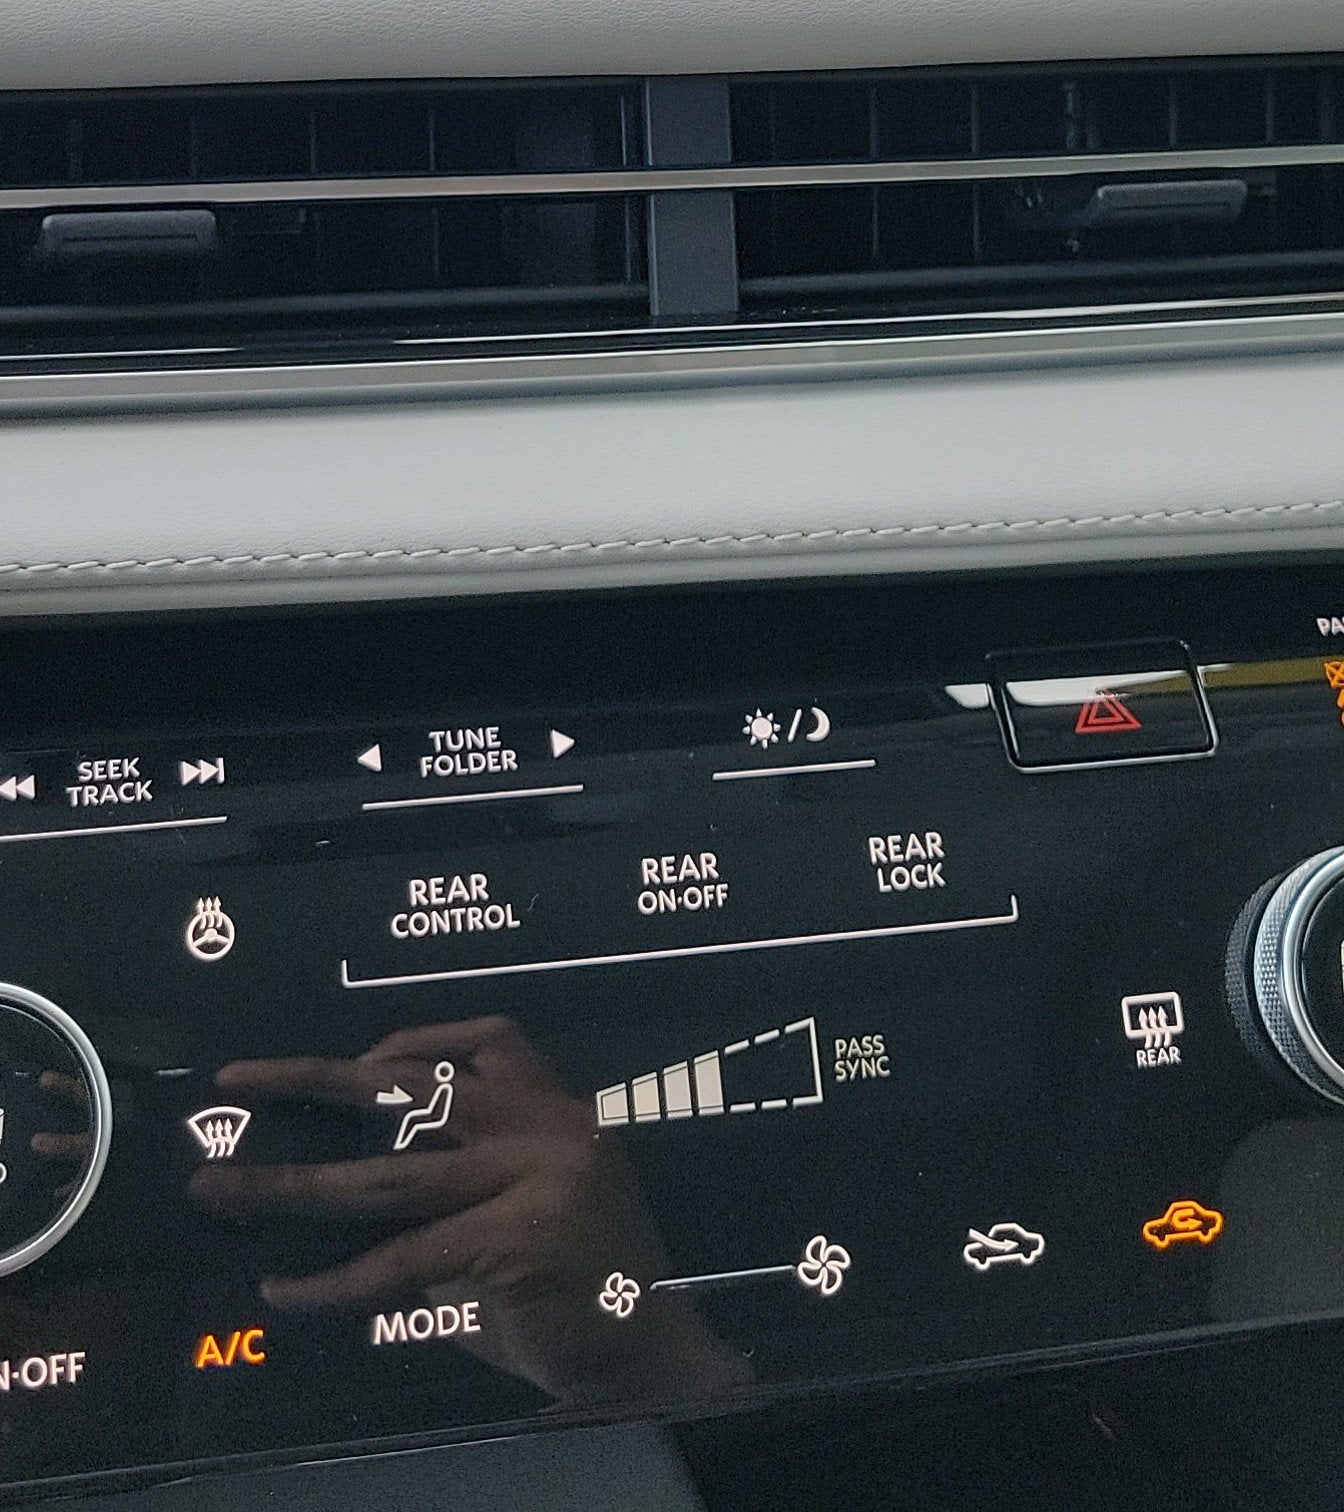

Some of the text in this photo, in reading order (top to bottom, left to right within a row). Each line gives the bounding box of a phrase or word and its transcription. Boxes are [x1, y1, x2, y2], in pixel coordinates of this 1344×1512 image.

[428, 725, 502, 754] TUNE
[77, 757, 141, 782] SEEK
[420, 747, 519, 778] FOLDER
[66, 779, 154, 807] TRACK
[868, 830, 945, 865] REAR
[640, 851, 720, 885] REAR
[876, 860, 947, 893] LOCK
[408, 873, 490, 908] REAR
[390, 904, 522, 940] CONTROL
[834, 1034, 887, 1060] PASS
[1135, 1044, 1183, 1069] REAR
[834, 1055, 892, 1082] SYNC
[372, 1300, 483, 1346] MODE
[194, 1327, 268, 1370] A/C
